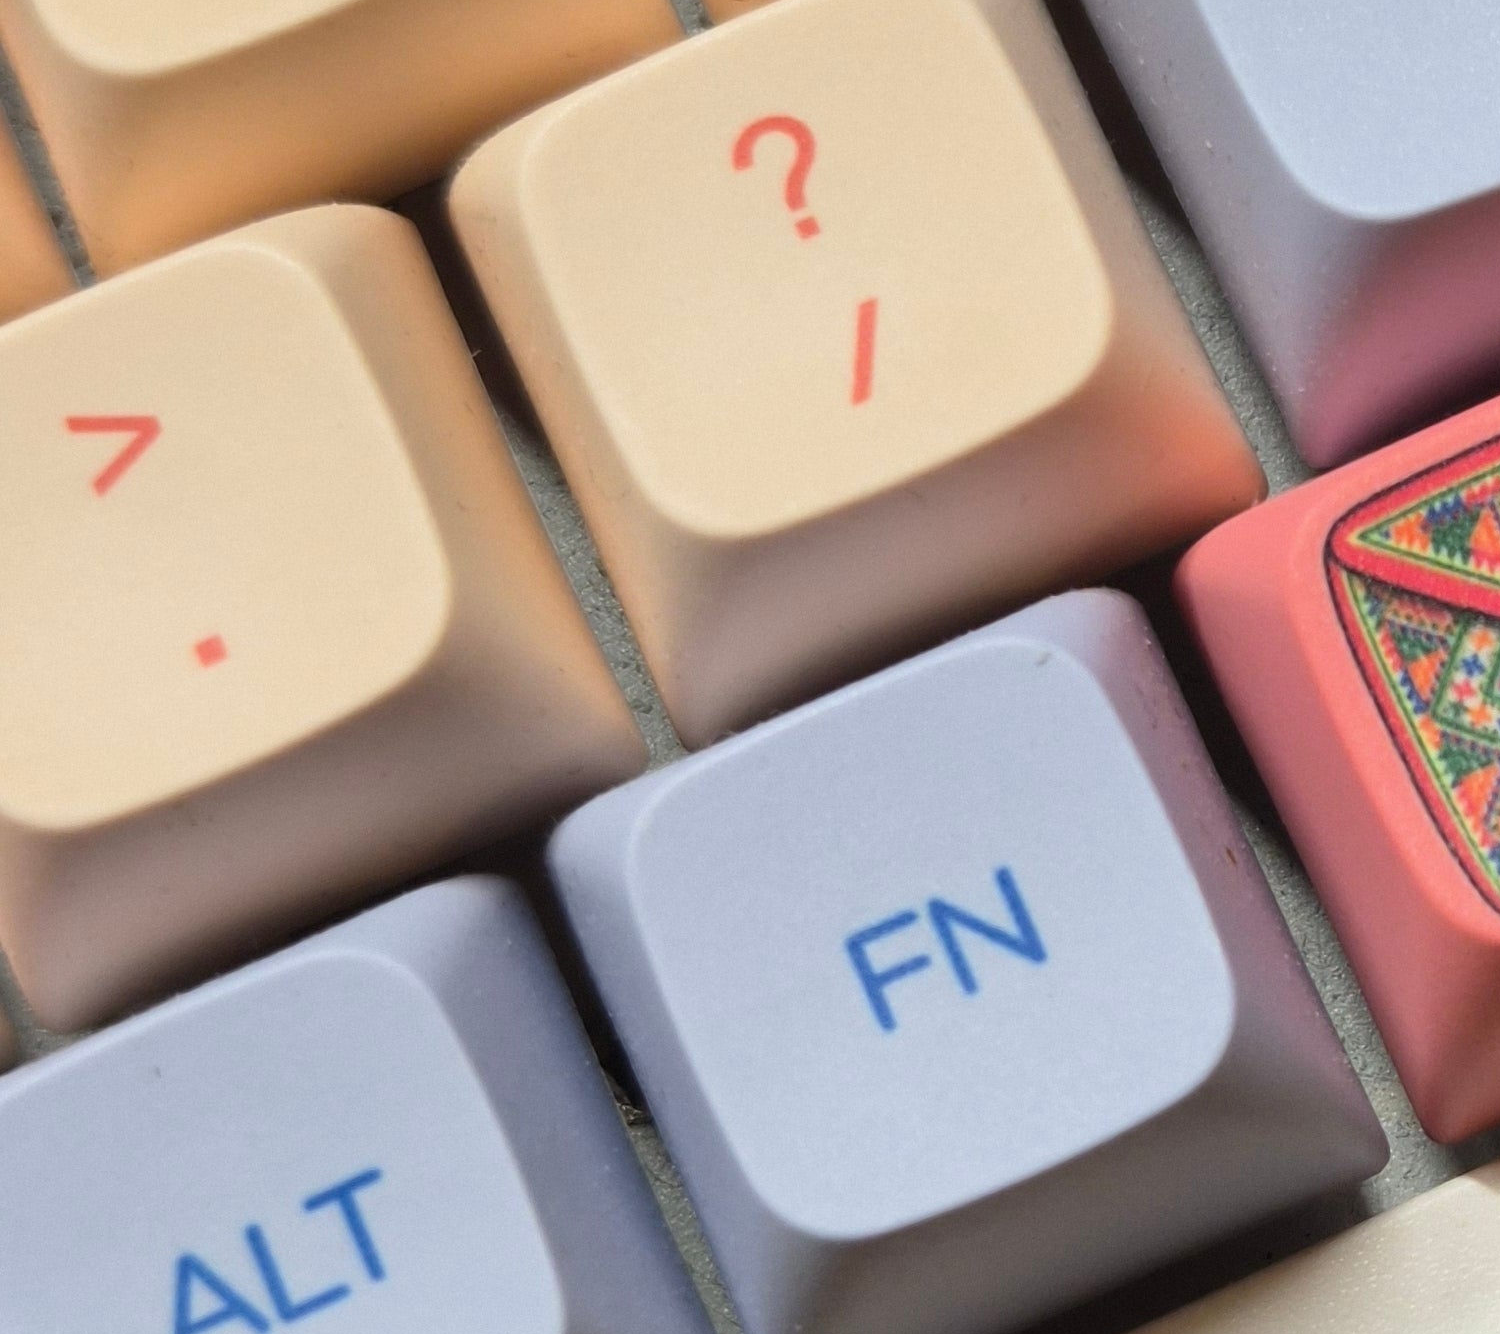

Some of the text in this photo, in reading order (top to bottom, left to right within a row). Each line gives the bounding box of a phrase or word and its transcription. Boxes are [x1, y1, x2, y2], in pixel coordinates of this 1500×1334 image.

[731, 114, 820, 240] ?
[850, 299, 878, 406] /
[64, 415, 161, 496] >
[193, 636, 227, 668] .
[844, 866, 1048, 1033] FN
